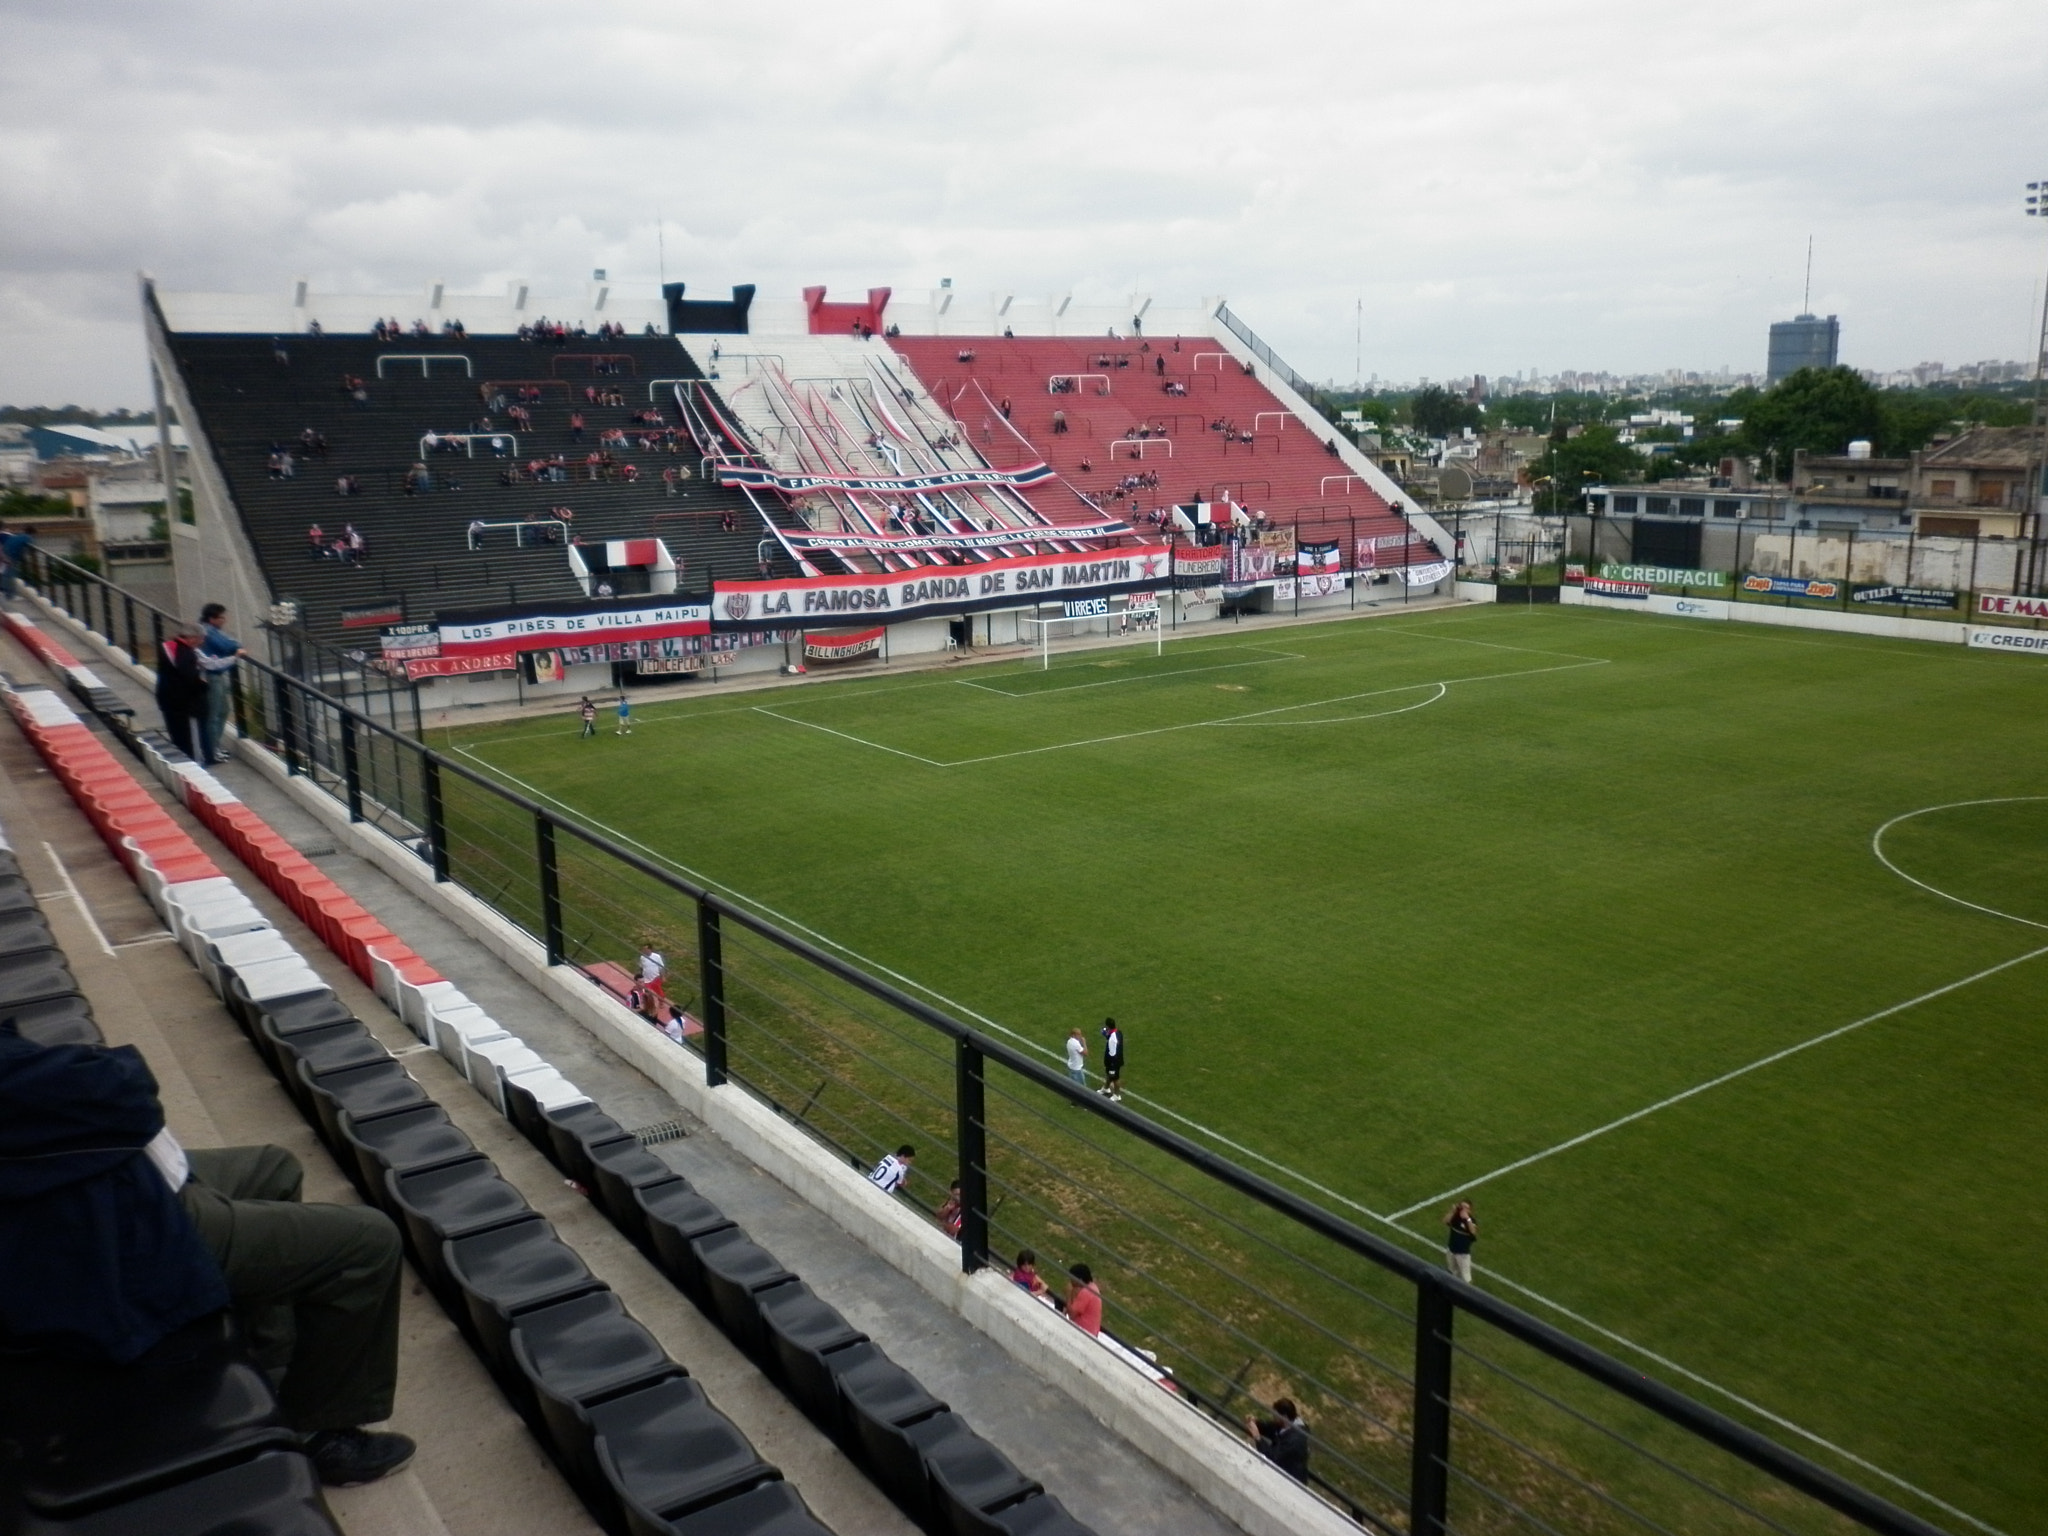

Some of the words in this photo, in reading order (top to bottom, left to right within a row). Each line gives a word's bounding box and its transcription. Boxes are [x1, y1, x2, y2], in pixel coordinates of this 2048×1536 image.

[790, 477, 851, 489] FAMOSA
[860, 480, 906, 490] BANDA
[915, 479, 934, 488] DE
[942, 473, 969, 485] SAN
[807, 538, 844, 548] COMO
[975, 535, 1007, 548] NADIE
[1009, 533, 1023, 541] LA
[1024, 530, 1056, 541] PUEDE
[1176, 546, 1221, 560] TERRITORIO
[1178, 560, 1221, 574] FUNEBRERO
[1621, 566, 1724, 587] CREDIFACIL
[762, 591, 792, 615] LA
[804, 587, 891, 612] FAMOSA
[902, 577, 970, 604] BANDA
[979, 573, 1005, 594] DE
[1016, 568, 1053, 591] SAN
[1062, 560, 1131, 585] MARTIN
[1584, 579, 1606, 592] VILLA
[1610, 584, 1649, 595] LIBERTAD
[1854, 586, 1893, 601] OUTLET
[1064, 598, 1108, 617] VIRREYES
[1981, 596, 2010, 614] DE
[461, 627, 493, 640] LOS
[507, 619, 556, 634] PIBES
[567, 618, 586, 630] DE
[597, 613, 642, 626] VILLA
[655, 608, 699, 621] MAIPU
[560, 647, 591, 666] LOS
[593, 641, 637, 661] PIBES
[640, 640, 660, 658] DE
[681, 630, 773, 654] CONCEPCION
[808, 637, 876, 658] BILLINGHURST
[409, 661, 440, 675] SAN
[450, 653, 513, 671] ANDRES
[648, 655, 706, 673] CONCEPCION
